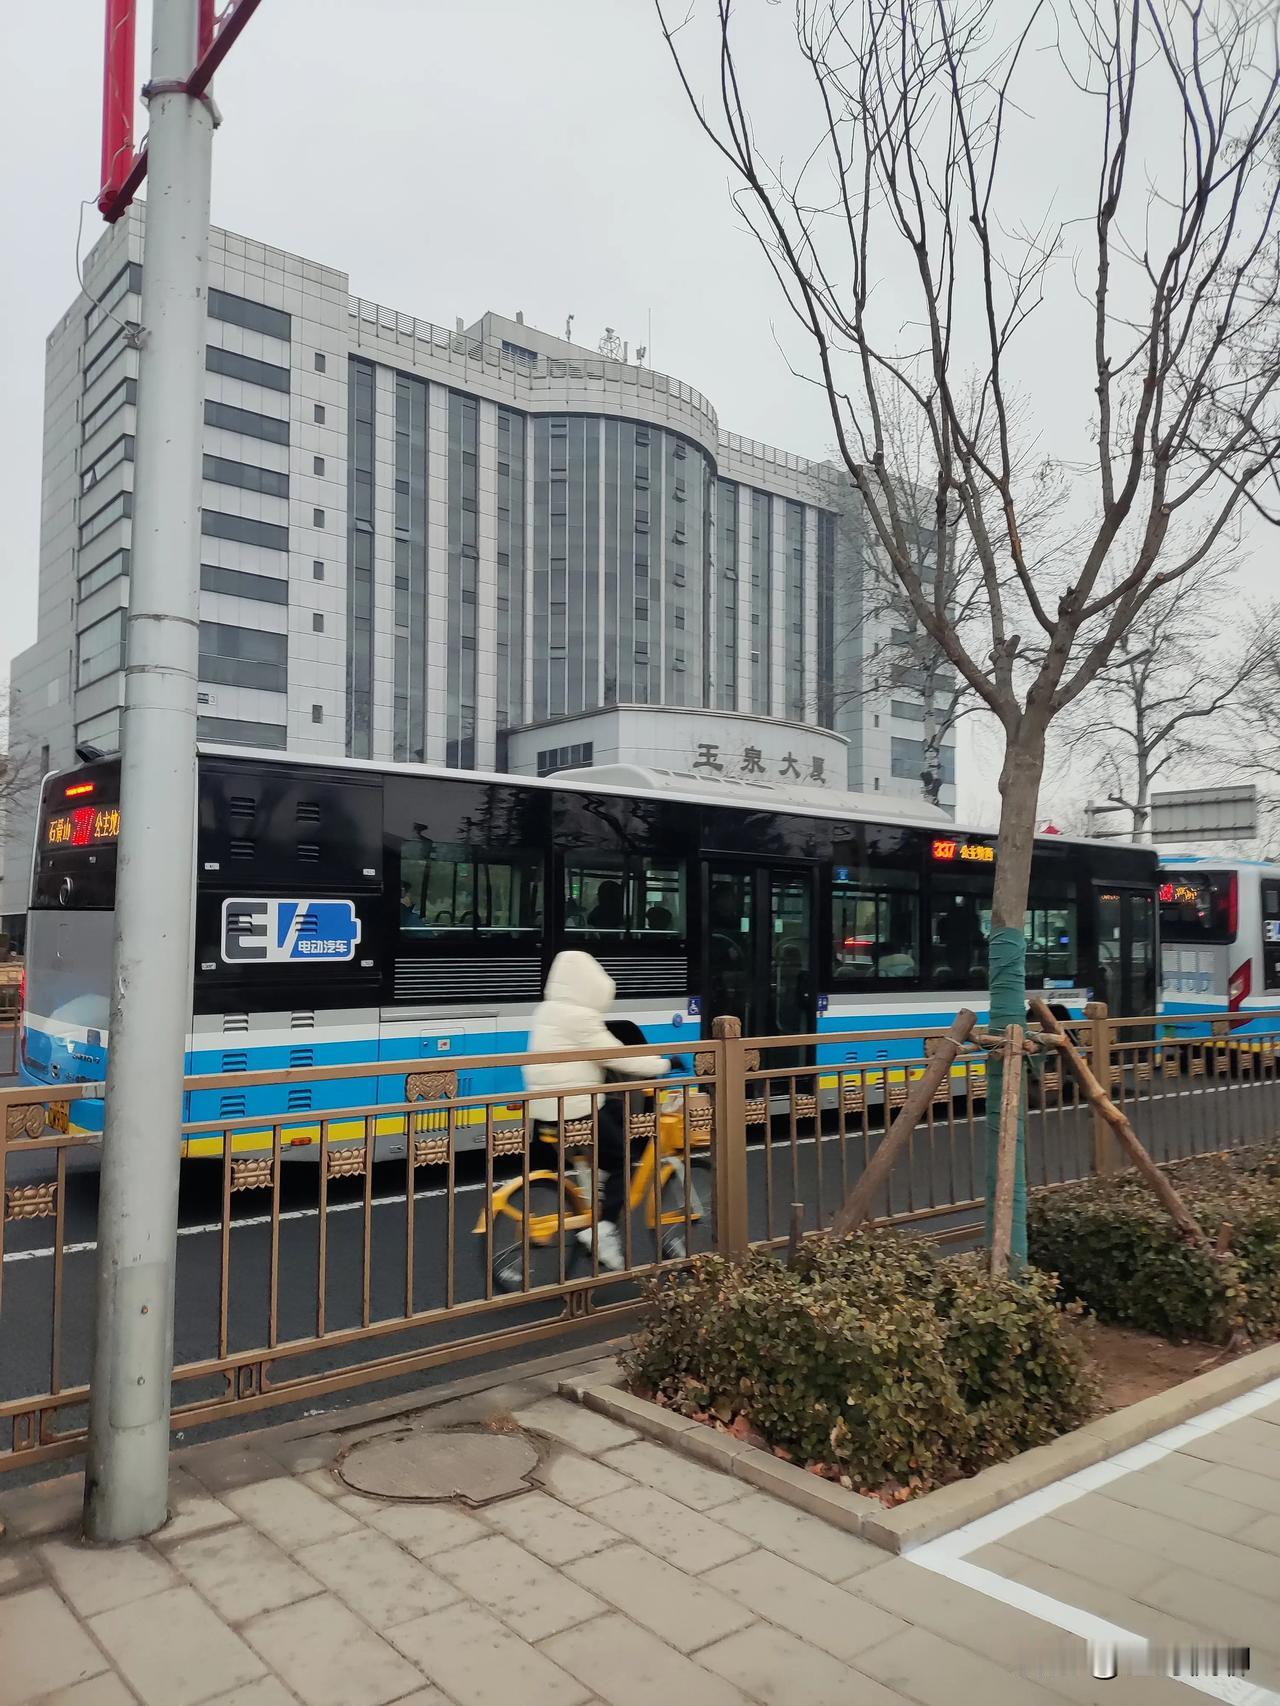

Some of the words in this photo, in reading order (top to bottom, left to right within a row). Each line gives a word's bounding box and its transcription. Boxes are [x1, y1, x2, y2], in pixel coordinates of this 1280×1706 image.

[693, 743, 826, 784] 玉泉大厦
[298, 940, 348, 954] 电动汽车
